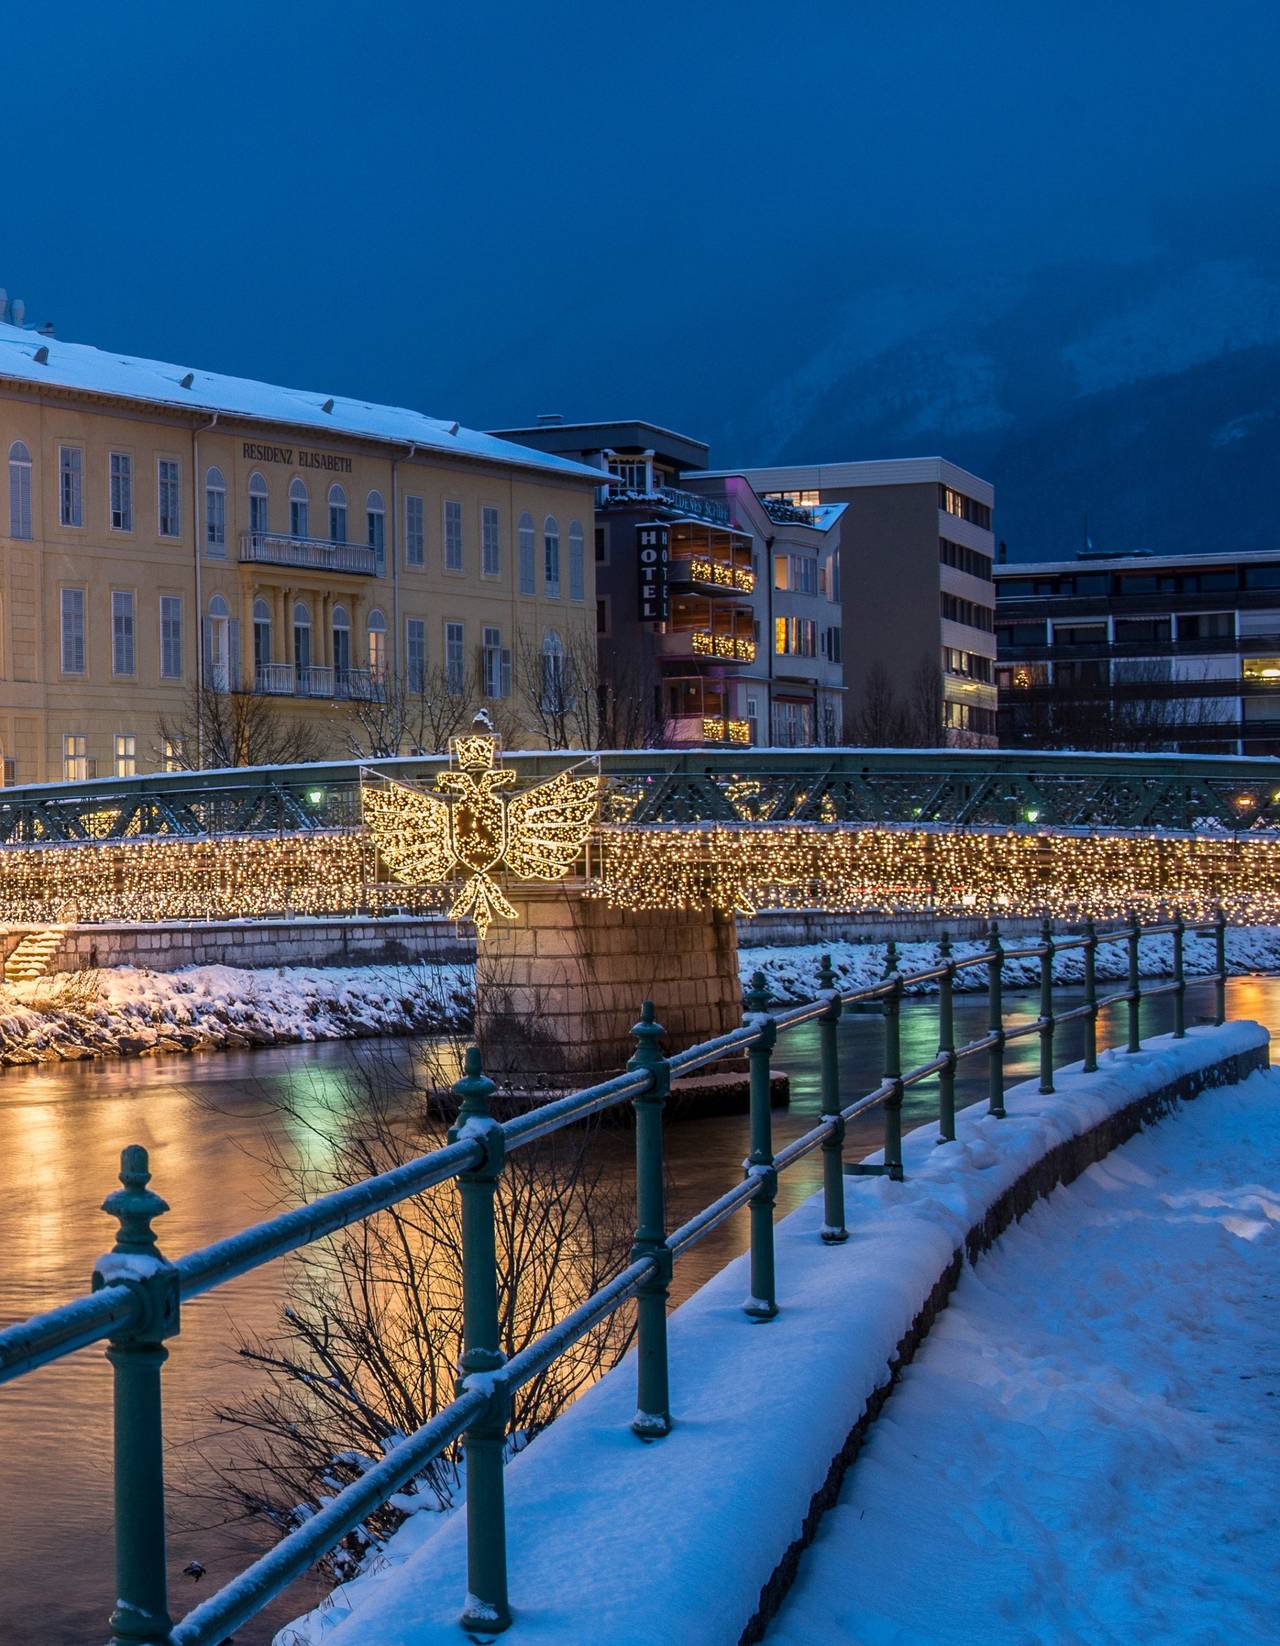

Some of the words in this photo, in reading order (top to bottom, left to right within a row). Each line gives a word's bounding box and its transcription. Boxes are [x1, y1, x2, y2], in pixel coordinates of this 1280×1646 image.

[242, 442, 293, 465] RESIDENZ
[298, 450, 353, 473] ELISABETH
[640, 530, 657, 617] HOTEL
